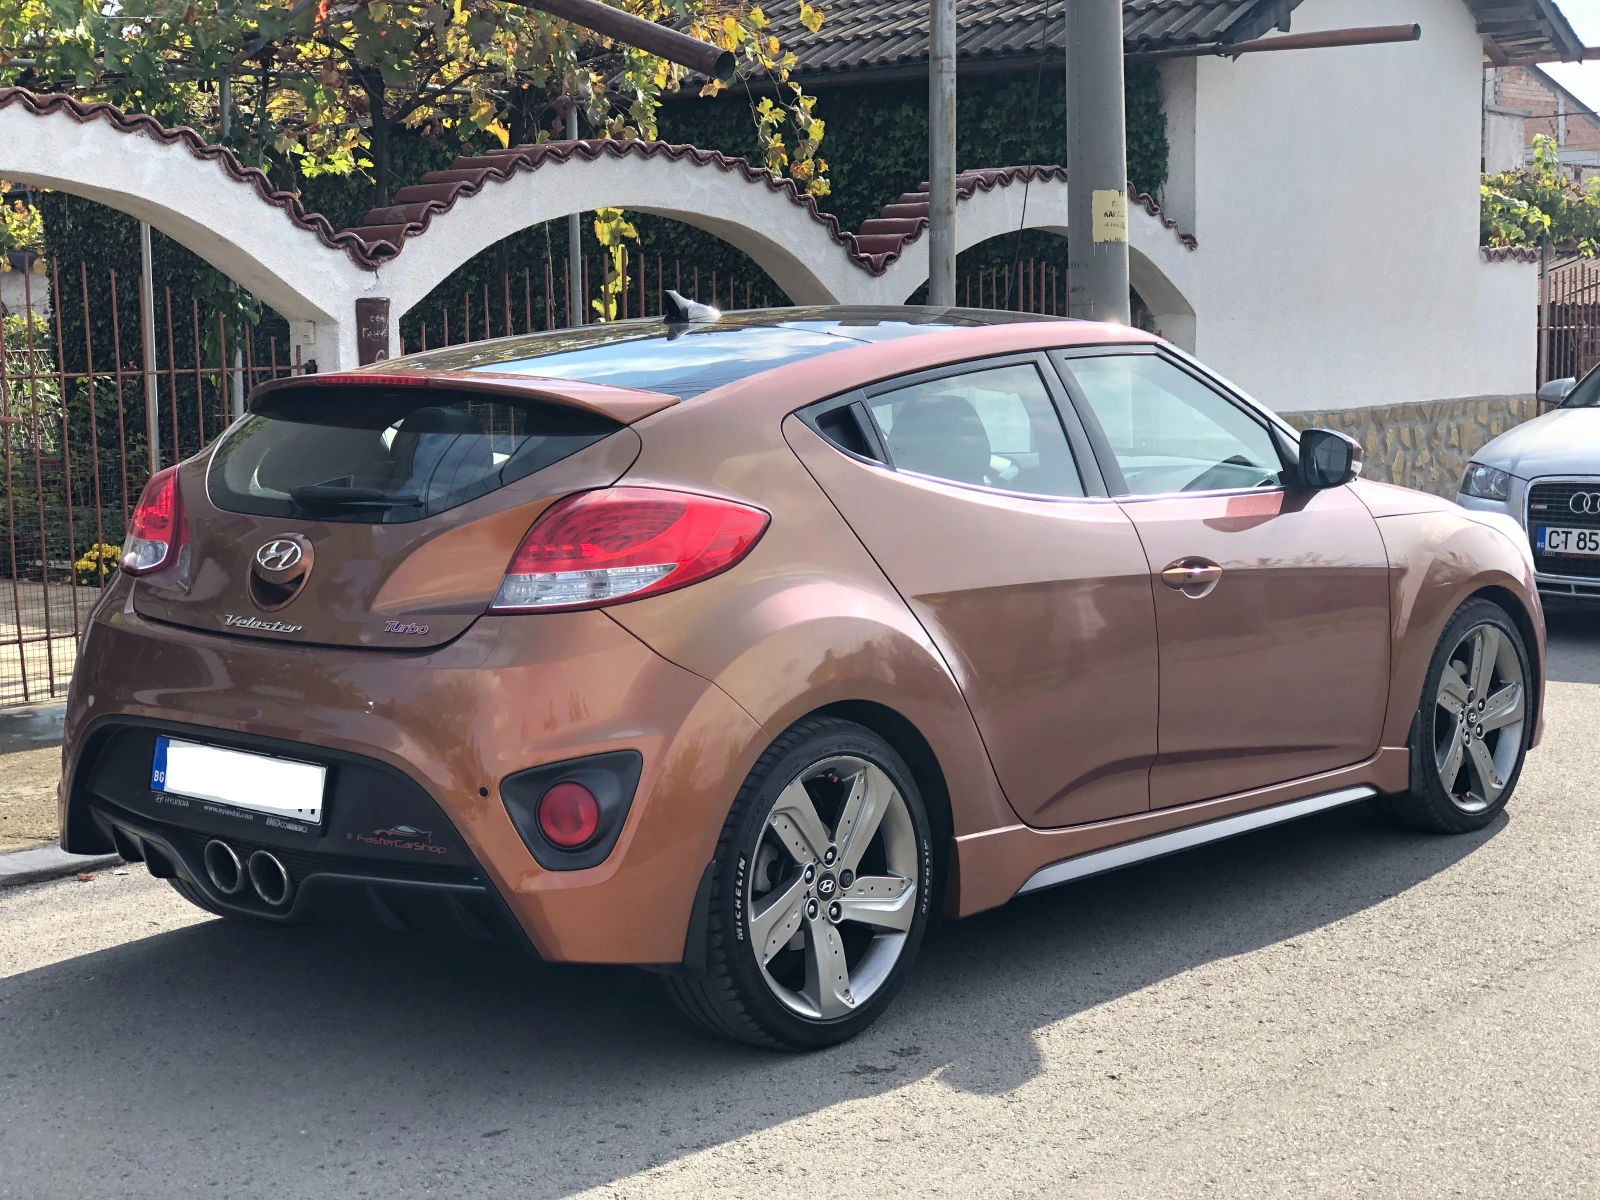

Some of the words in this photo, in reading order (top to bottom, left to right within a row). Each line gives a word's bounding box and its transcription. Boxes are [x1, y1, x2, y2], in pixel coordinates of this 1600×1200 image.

[1536, 541, 1545, 549] BG
[1548, 530, 1573, 550] CT
[1576, 531, 1600, 552] 85
[225, 614, 302, 633] Veloster
[384, 620, 430, 635] Turbo
[153, 769, 165, 784] BG
[735, 856, 747, 941] MICHELIN
